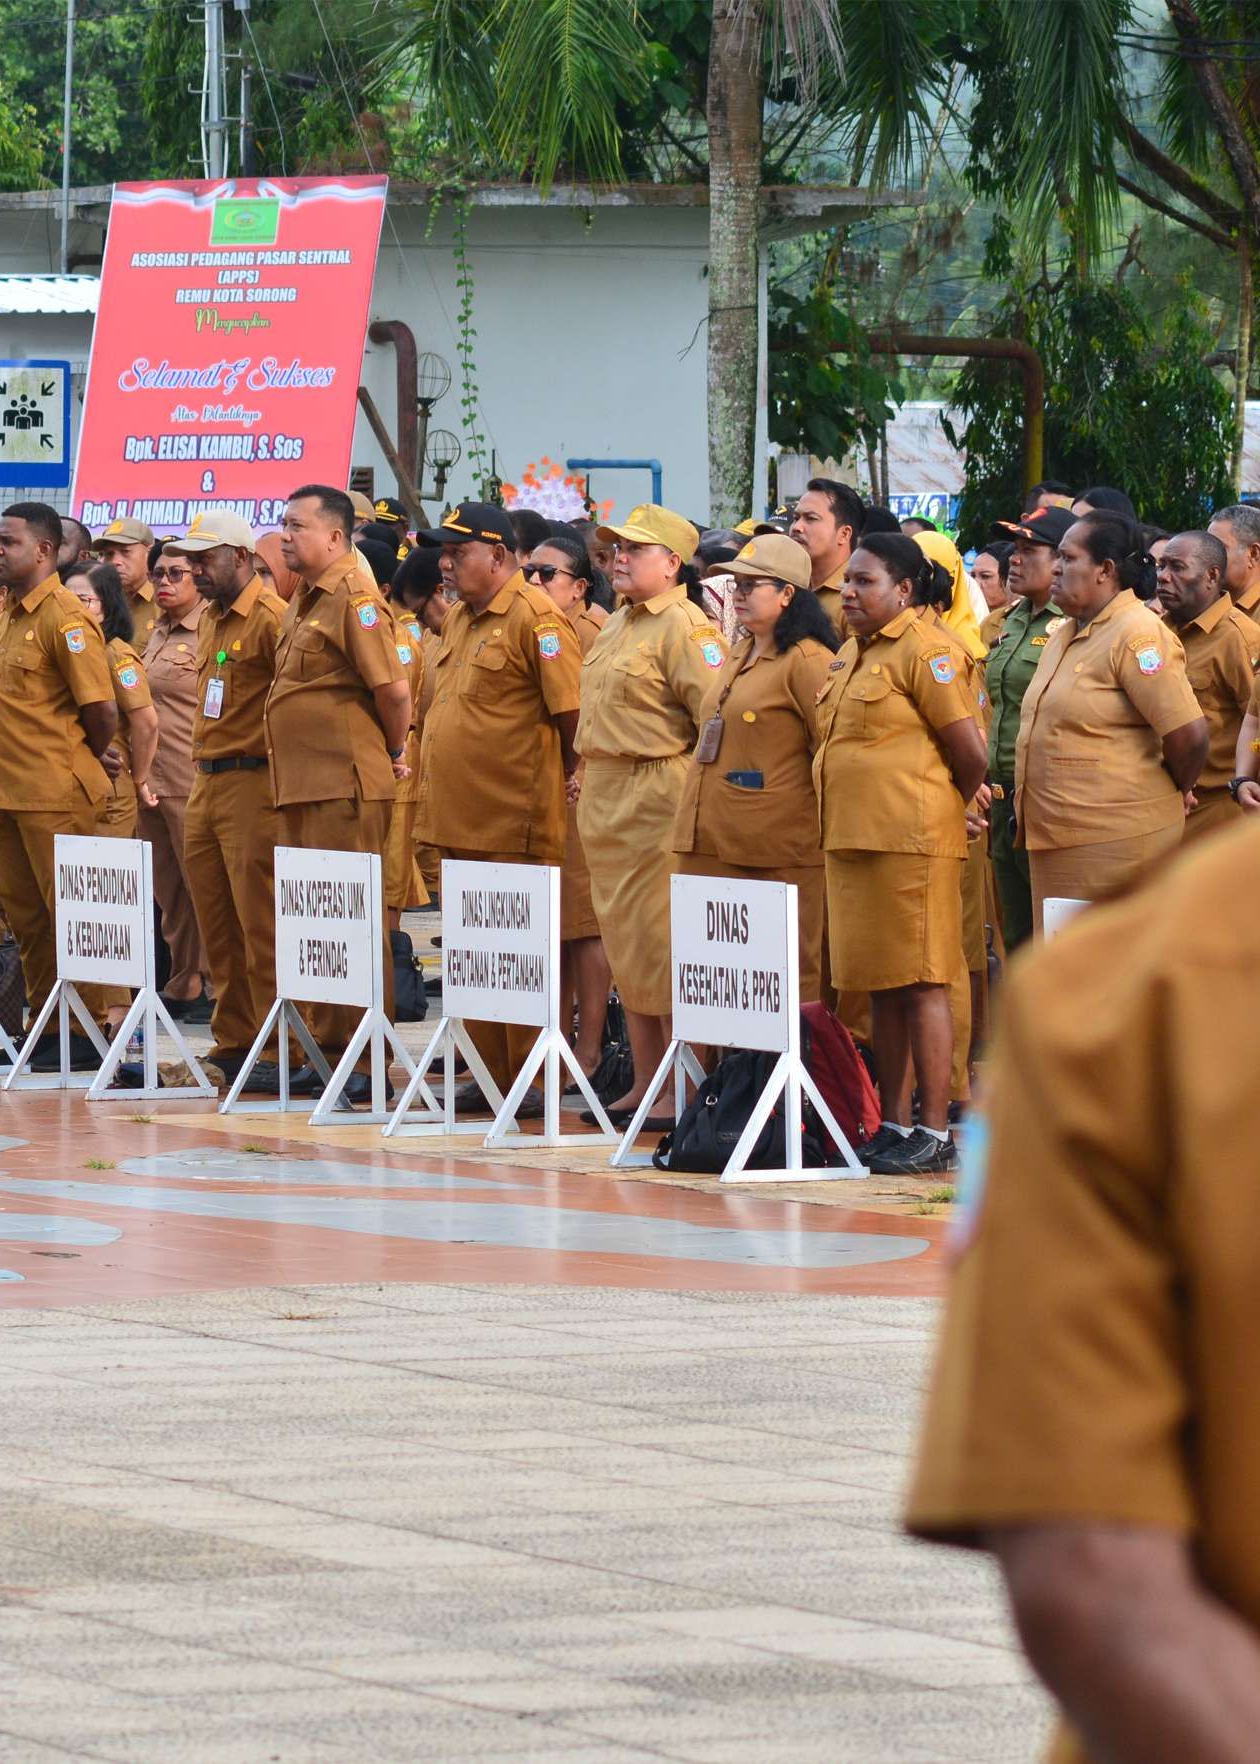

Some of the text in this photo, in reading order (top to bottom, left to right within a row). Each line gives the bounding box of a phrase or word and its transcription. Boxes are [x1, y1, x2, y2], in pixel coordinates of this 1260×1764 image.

[131, 249, 351, 267] ASOSIASI PEDAGANG PASAR SENTRAL
[218, 270, 260, 284] (APPS)
[175, 287, 297, 303] REMU KOTA SORONG
[118, 358, 224, 392] Selamat
[247, 357, 336, 391] Sukses
[125, 434, 304, 463] Bpk. ELISA KAMBU, S. Sos
[201, 470, 214, 492] &
[82, 501, 113, 527] Bpk.
[132, 499, 185, 525] AHMAD
[59, 864, 138, 906] DINAS PENDIDIKAN
[281, 879, 304, 917] DINAS
[306, 880, 346, 919] KOPERASI
[462, 890, 530, 930] DINAS LINGKUNGAN
[707, 901, 749, 944] DINAS
[67, 920, 131, 961] & KEBUDAYAAN
[299, 938, 348, 979] & PERINDAG
[447, 949, 544, 993] KEHUTANAN & PERTANAHAN
[679, 963, 780, 1013] KESEHATAN & PPKB
